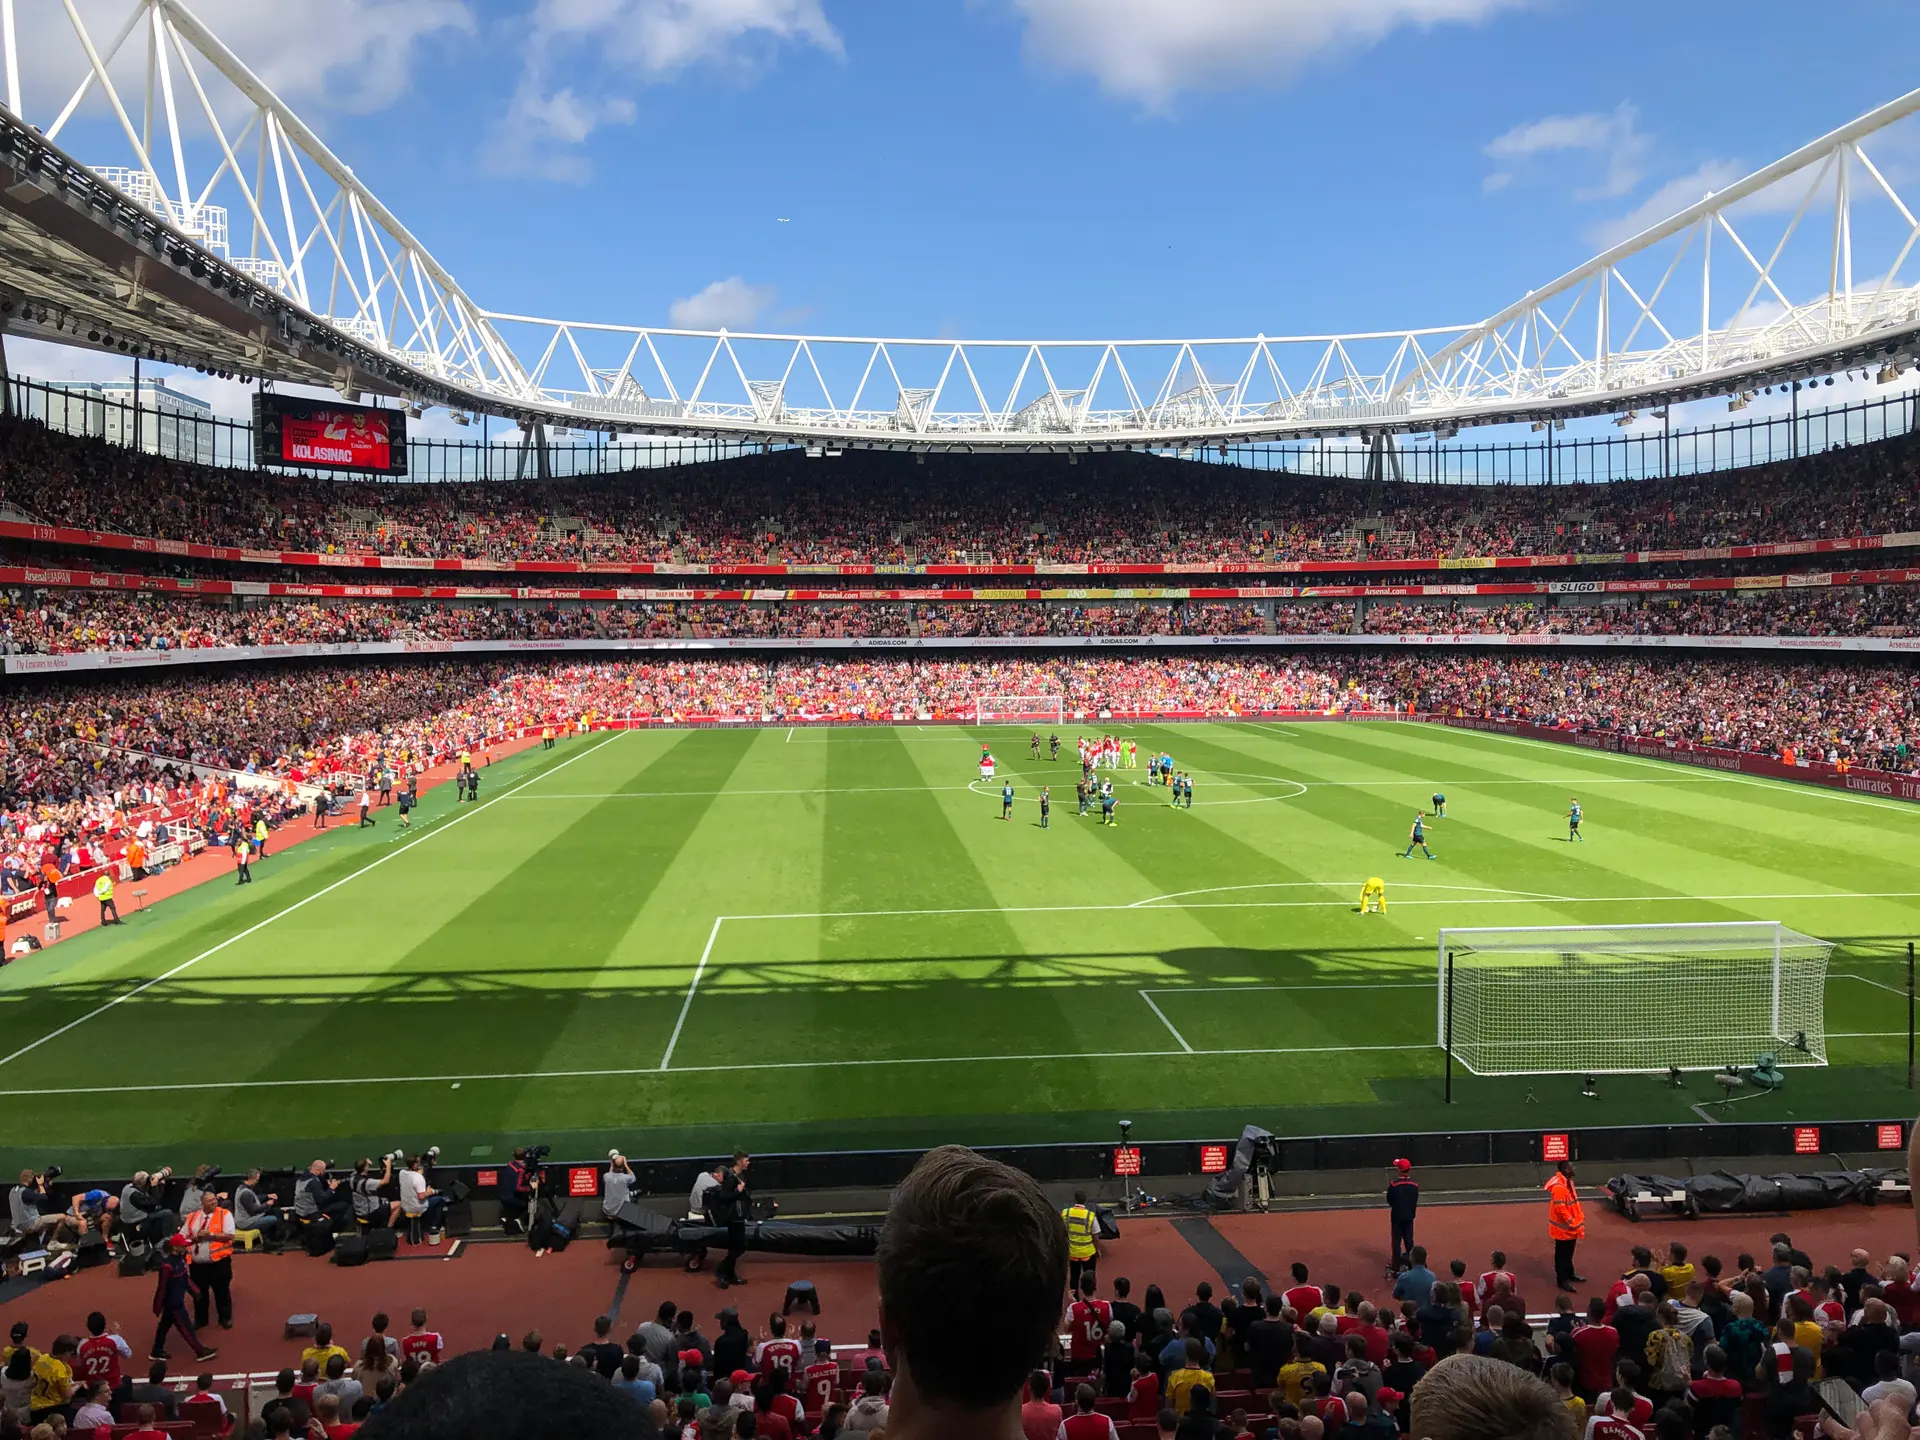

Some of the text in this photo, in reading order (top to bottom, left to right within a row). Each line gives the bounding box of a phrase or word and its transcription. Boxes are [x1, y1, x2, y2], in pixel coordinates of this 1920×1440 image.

[351, 442, 372, 450] Emirates
[292, 444, 352, 463] KOLASINAC
[41, 528, 56, 539] 1971
[1864, 538, 1882, 547] 1998
[874, 566, 909, 574] ANFIELD
[975, 565, 993, 573] 1991
[25, 570, 71, 584] Arsenal JAPAN
[90, 575, 109, 586] Arsenal
[285, 586, 323, 595] Arsenal.com
[344, 587, 393, 595] ARSENAL SWEDEN
[1560, 583, 1596, 592] SLIGO
[554, 590, 580, 598] Arsenal
[817, 591, 858, 599] Arsenal.com
[981, 590, 1026, 599] AUSTRALIA
[1067, 590, 1087, 599] AND
[1161, 589, 1189, 598] AGAIN
[1779, 639, 1842, 648] Arsenal.com/membership
[16, 659, 25, 671] Fly
[25, 658, 46, 669] Emirates
[52, 658, 68, 668] Africa
[648, 721, 690, 729] Emirates
[788, 720, 802, 728] this
[1346, 714, 1388, 722] Emirates
[1430, 717, 1445, 725] and
[1447, 718, 1464, 728] watch
[1464, 719, 1475, 729] this
[1475, 721, 1490, 732] game
[1575, 733, 1600, 747] Emirates
[1627, 743, 1639, 753] and
[1639, 744, 1658, 756] watch
[1673, 750, 1692, 764] game
[1693, 750, 1705, 764] live
[1706, 756, 1717, 766] on
[1718, 755, 1741, 770] board
[1846, 774, 1892, 794] Emirates
[1902, 782, 1915, 798] FLY
[1084, 1320, 1104, 1341] 16
[86, 1356, 110, 1375] 22
[817, 1380, 831, 1402] 9
